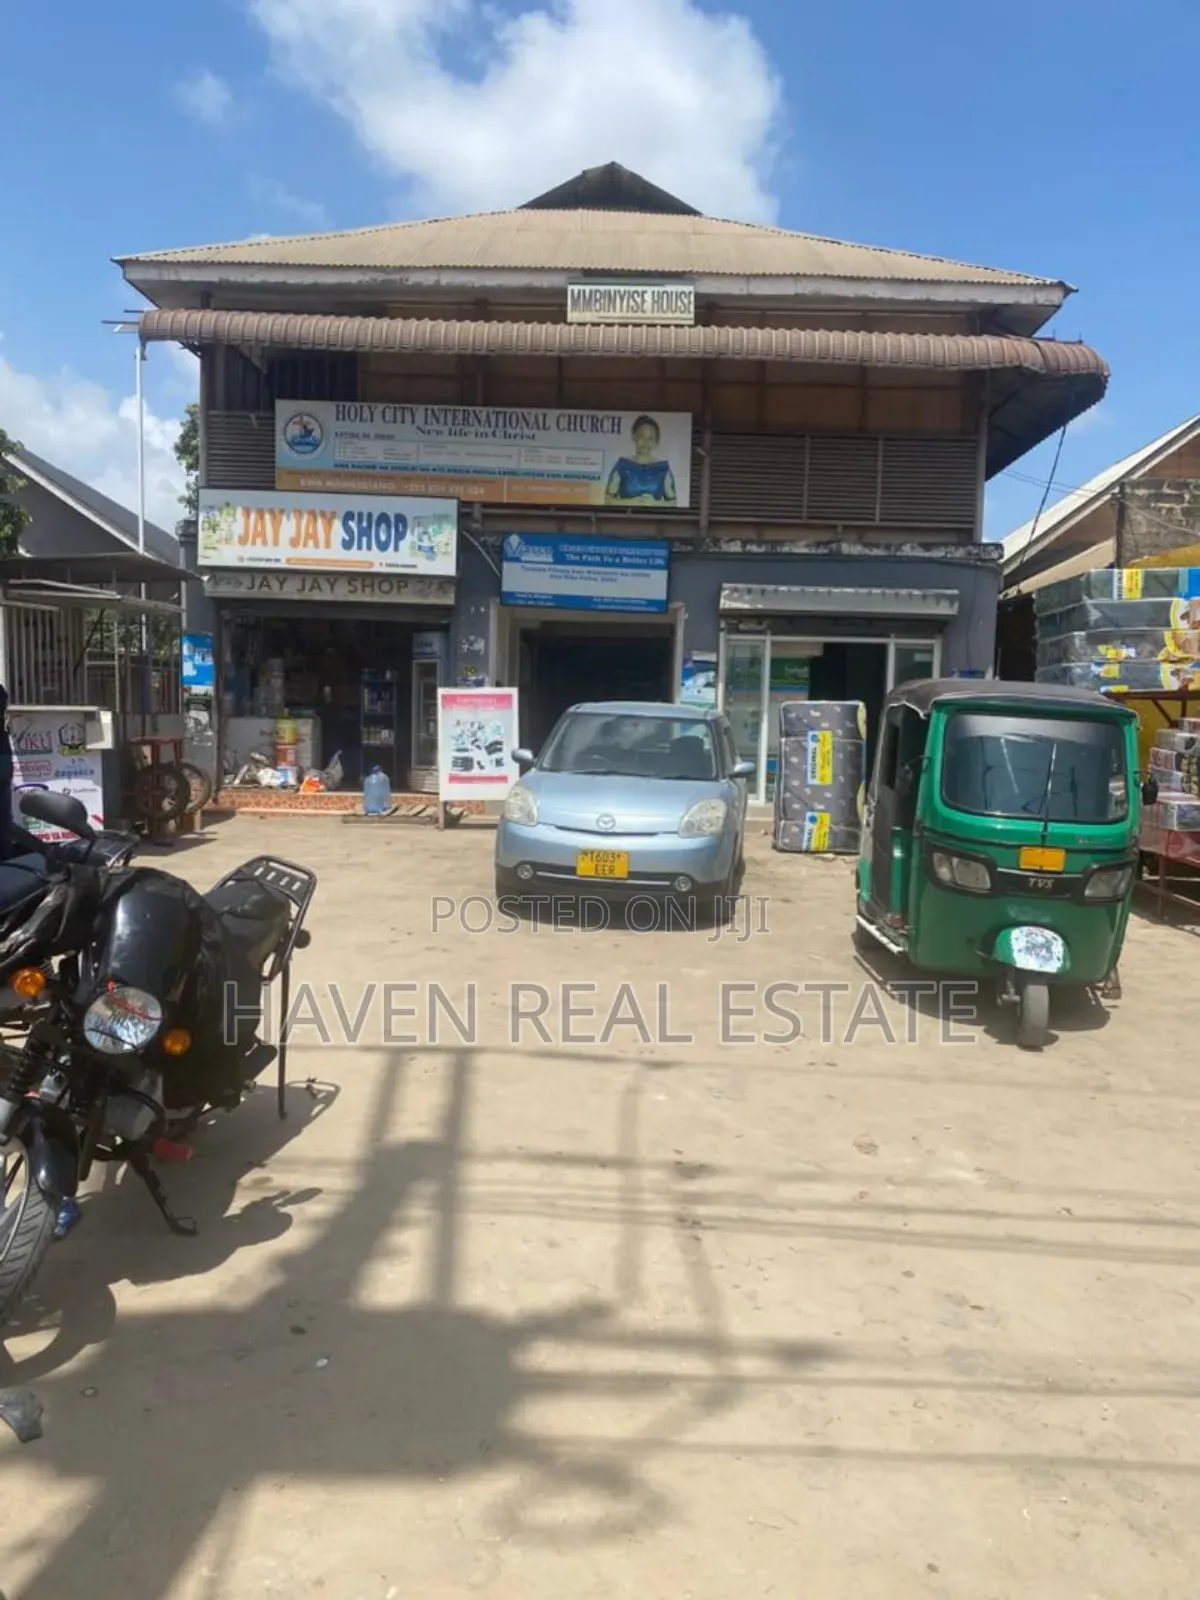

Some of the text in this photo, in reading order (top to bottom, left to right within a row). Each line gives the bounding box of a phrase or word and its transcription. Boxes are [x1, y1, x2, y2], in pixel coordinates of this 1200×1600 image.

[652, 289, 693, 315] HOUSE
[335, 403, 622, 435] HOLY CITY INTERNATIONAL CHURCH
[416, 426, 444, 437] New
[474, 431, 488, 439] in
[492, 430, 537, 441] Christ
[238, 507, 408, 552] JAY JAY SHOP
[246, 575, 286, 590] JAY
[296, 577, 338, 594] JAY
[347, 578, 410, 595] SHOP
[594, 863, 616, 875] EER
[1028, 876, 1055, 890] TVS
